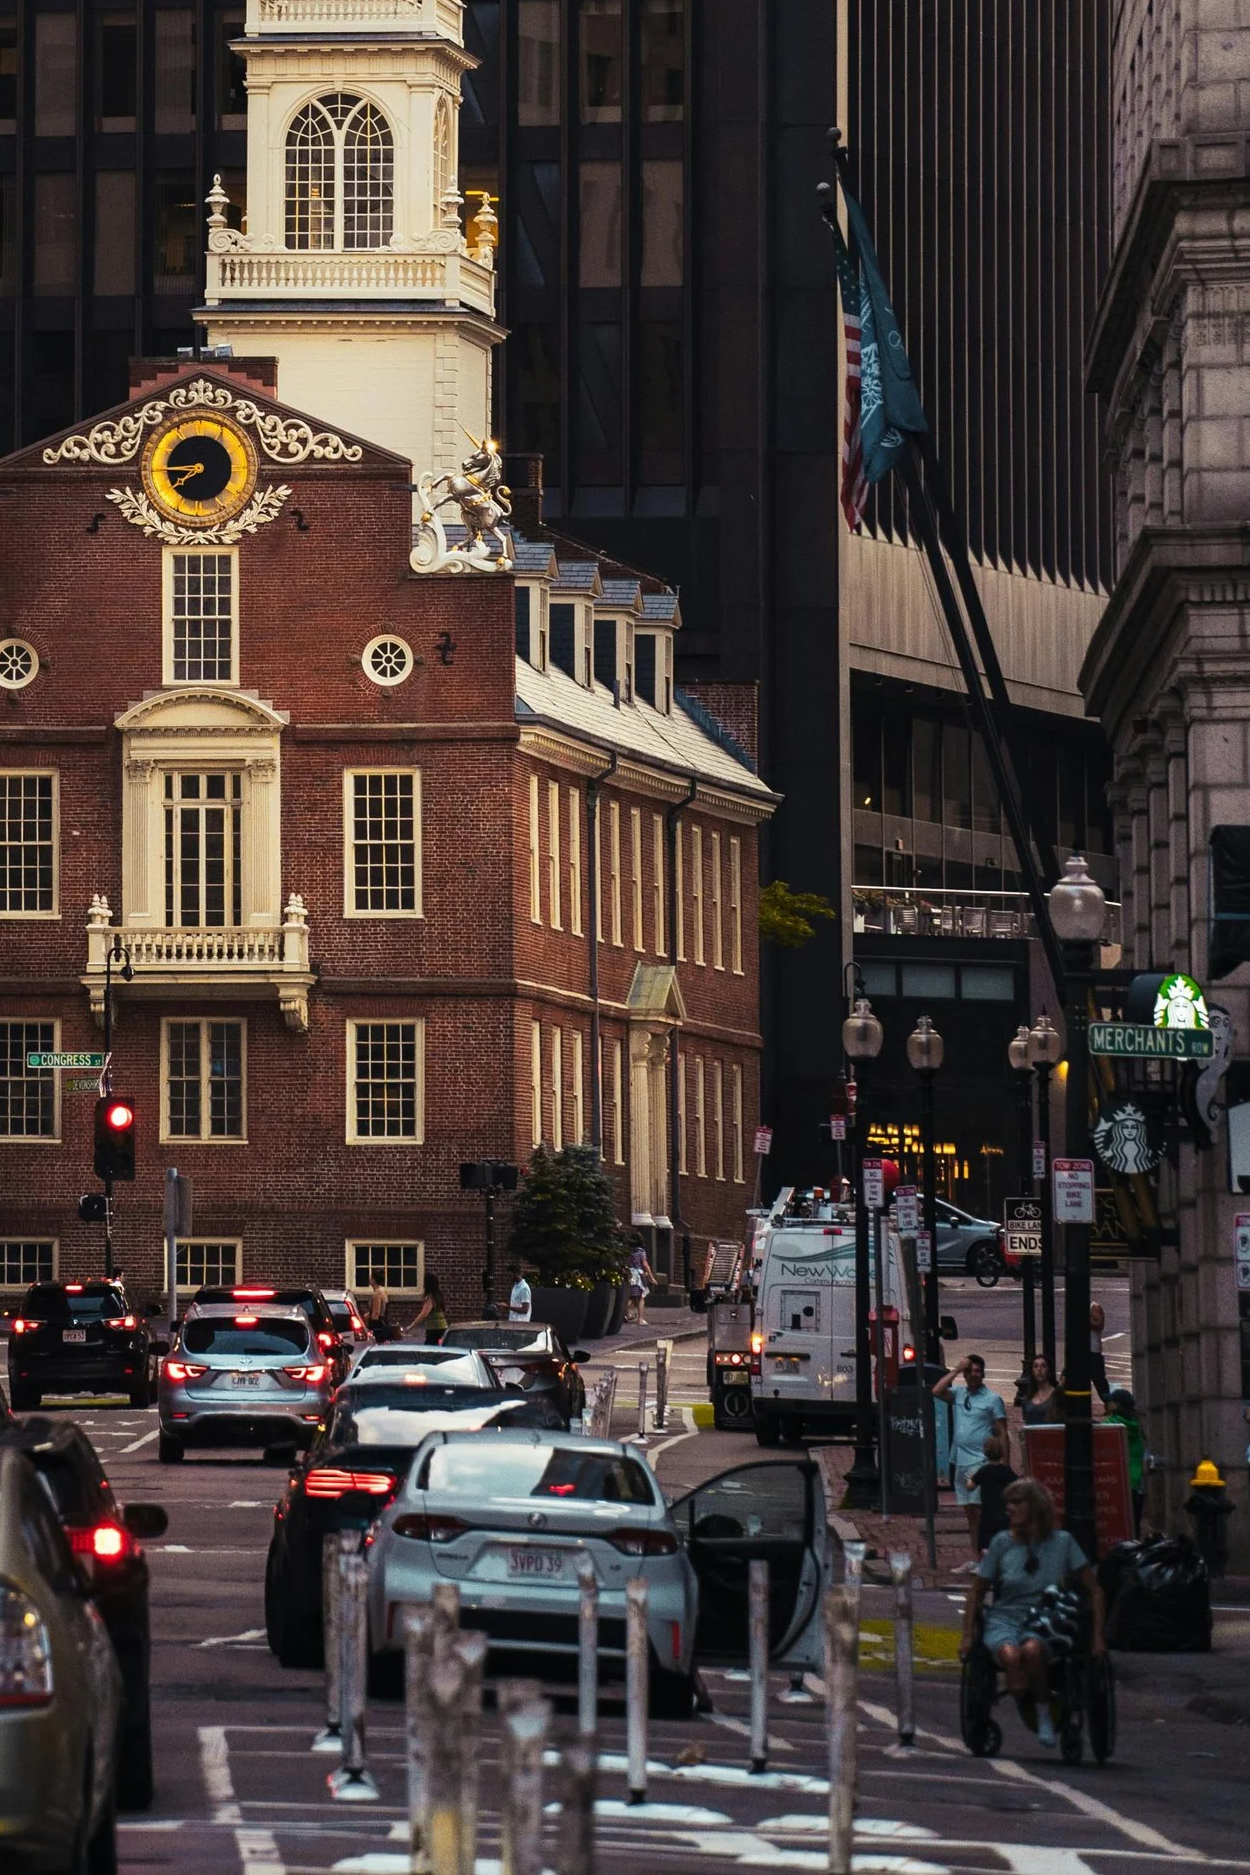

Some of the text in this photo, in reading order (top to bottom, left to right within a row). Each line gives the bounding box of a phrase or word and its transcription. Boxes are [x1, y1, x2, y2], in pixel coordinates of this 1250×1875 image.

[1093, 1027, 1209, 1054] MERCHANTS ROW
[41, 1054, 91, 1066] CONGRESS
[1057, 1181, 1090, 1189] STOPPING
[1065, 1200, 1083, 1208] LANE
[1009, 1221, 1026, 1230] BIKE
[837, 1364, 853, 1373] 603
